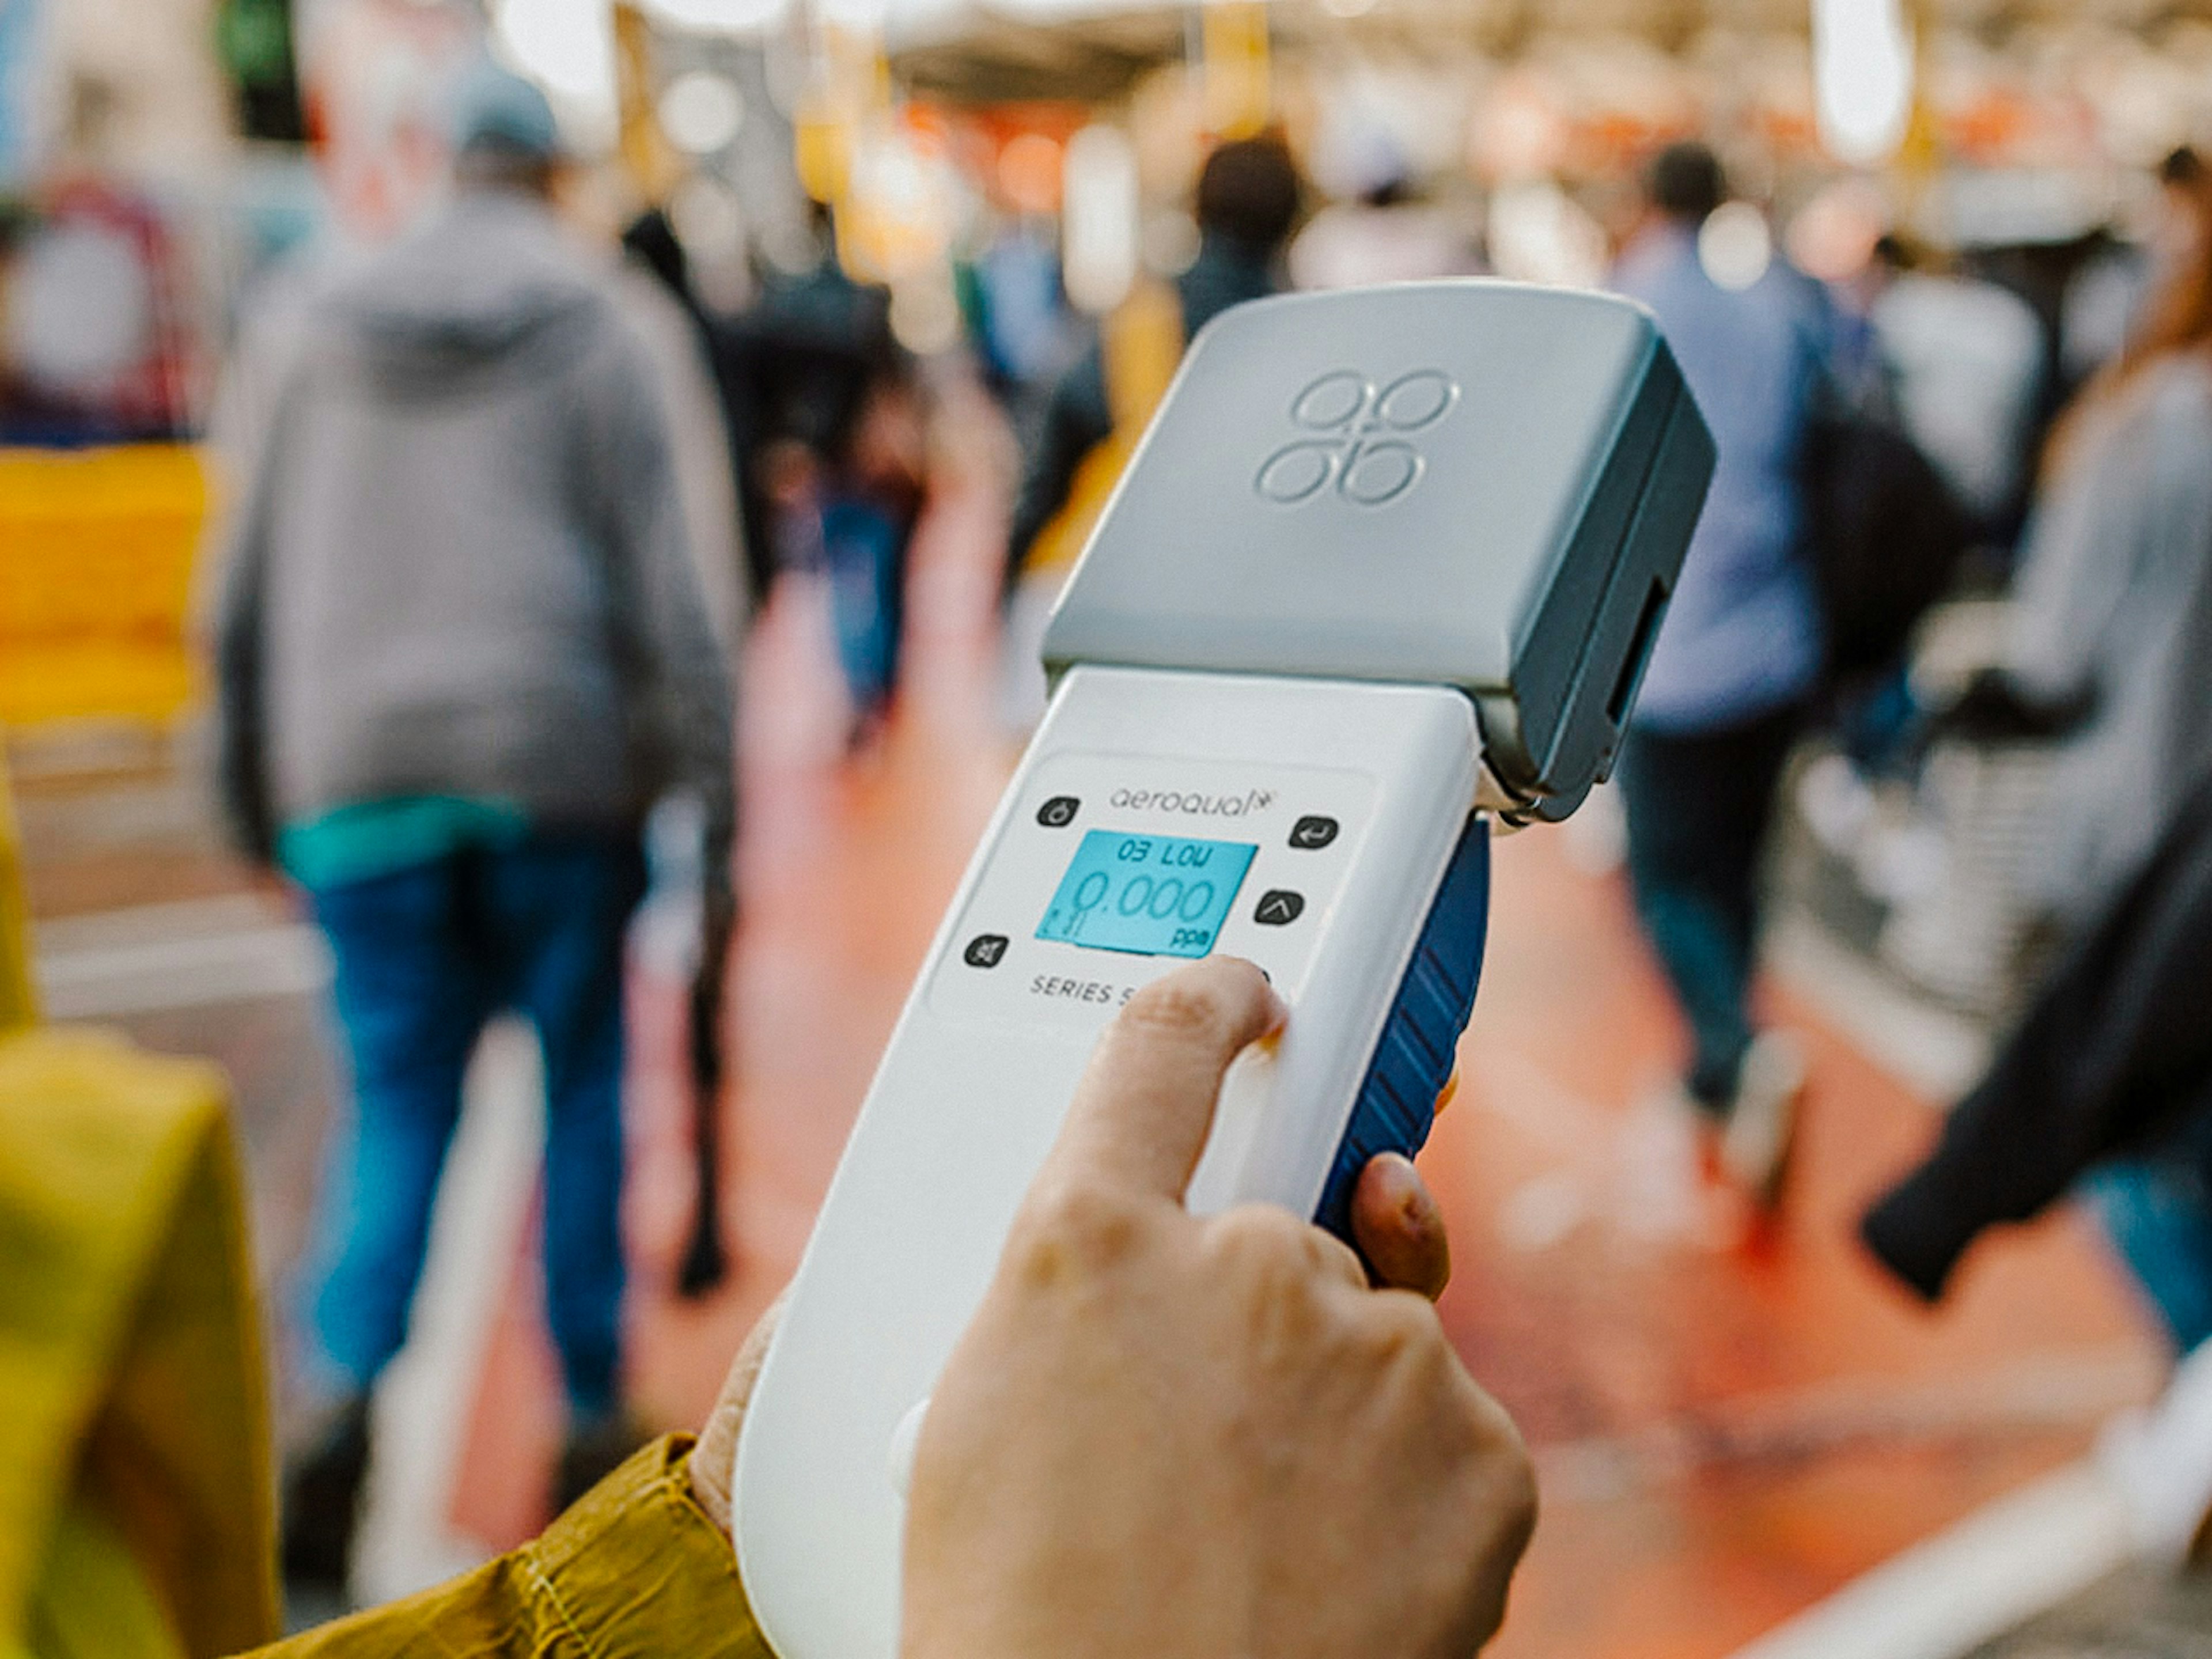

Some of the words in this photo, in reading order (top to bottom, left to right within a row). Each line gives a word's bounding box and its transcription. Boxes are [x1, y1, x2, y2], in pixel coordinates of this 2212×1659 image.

[1109, 787, 1257, 816] aeroqual
[1160, 843, 1213, 868] LOW
[1073, 870, 1215, 923] 0.000
[1169, 927, 1210, 948] ppm
[1030, 975, 1113, 1003] SERIES
